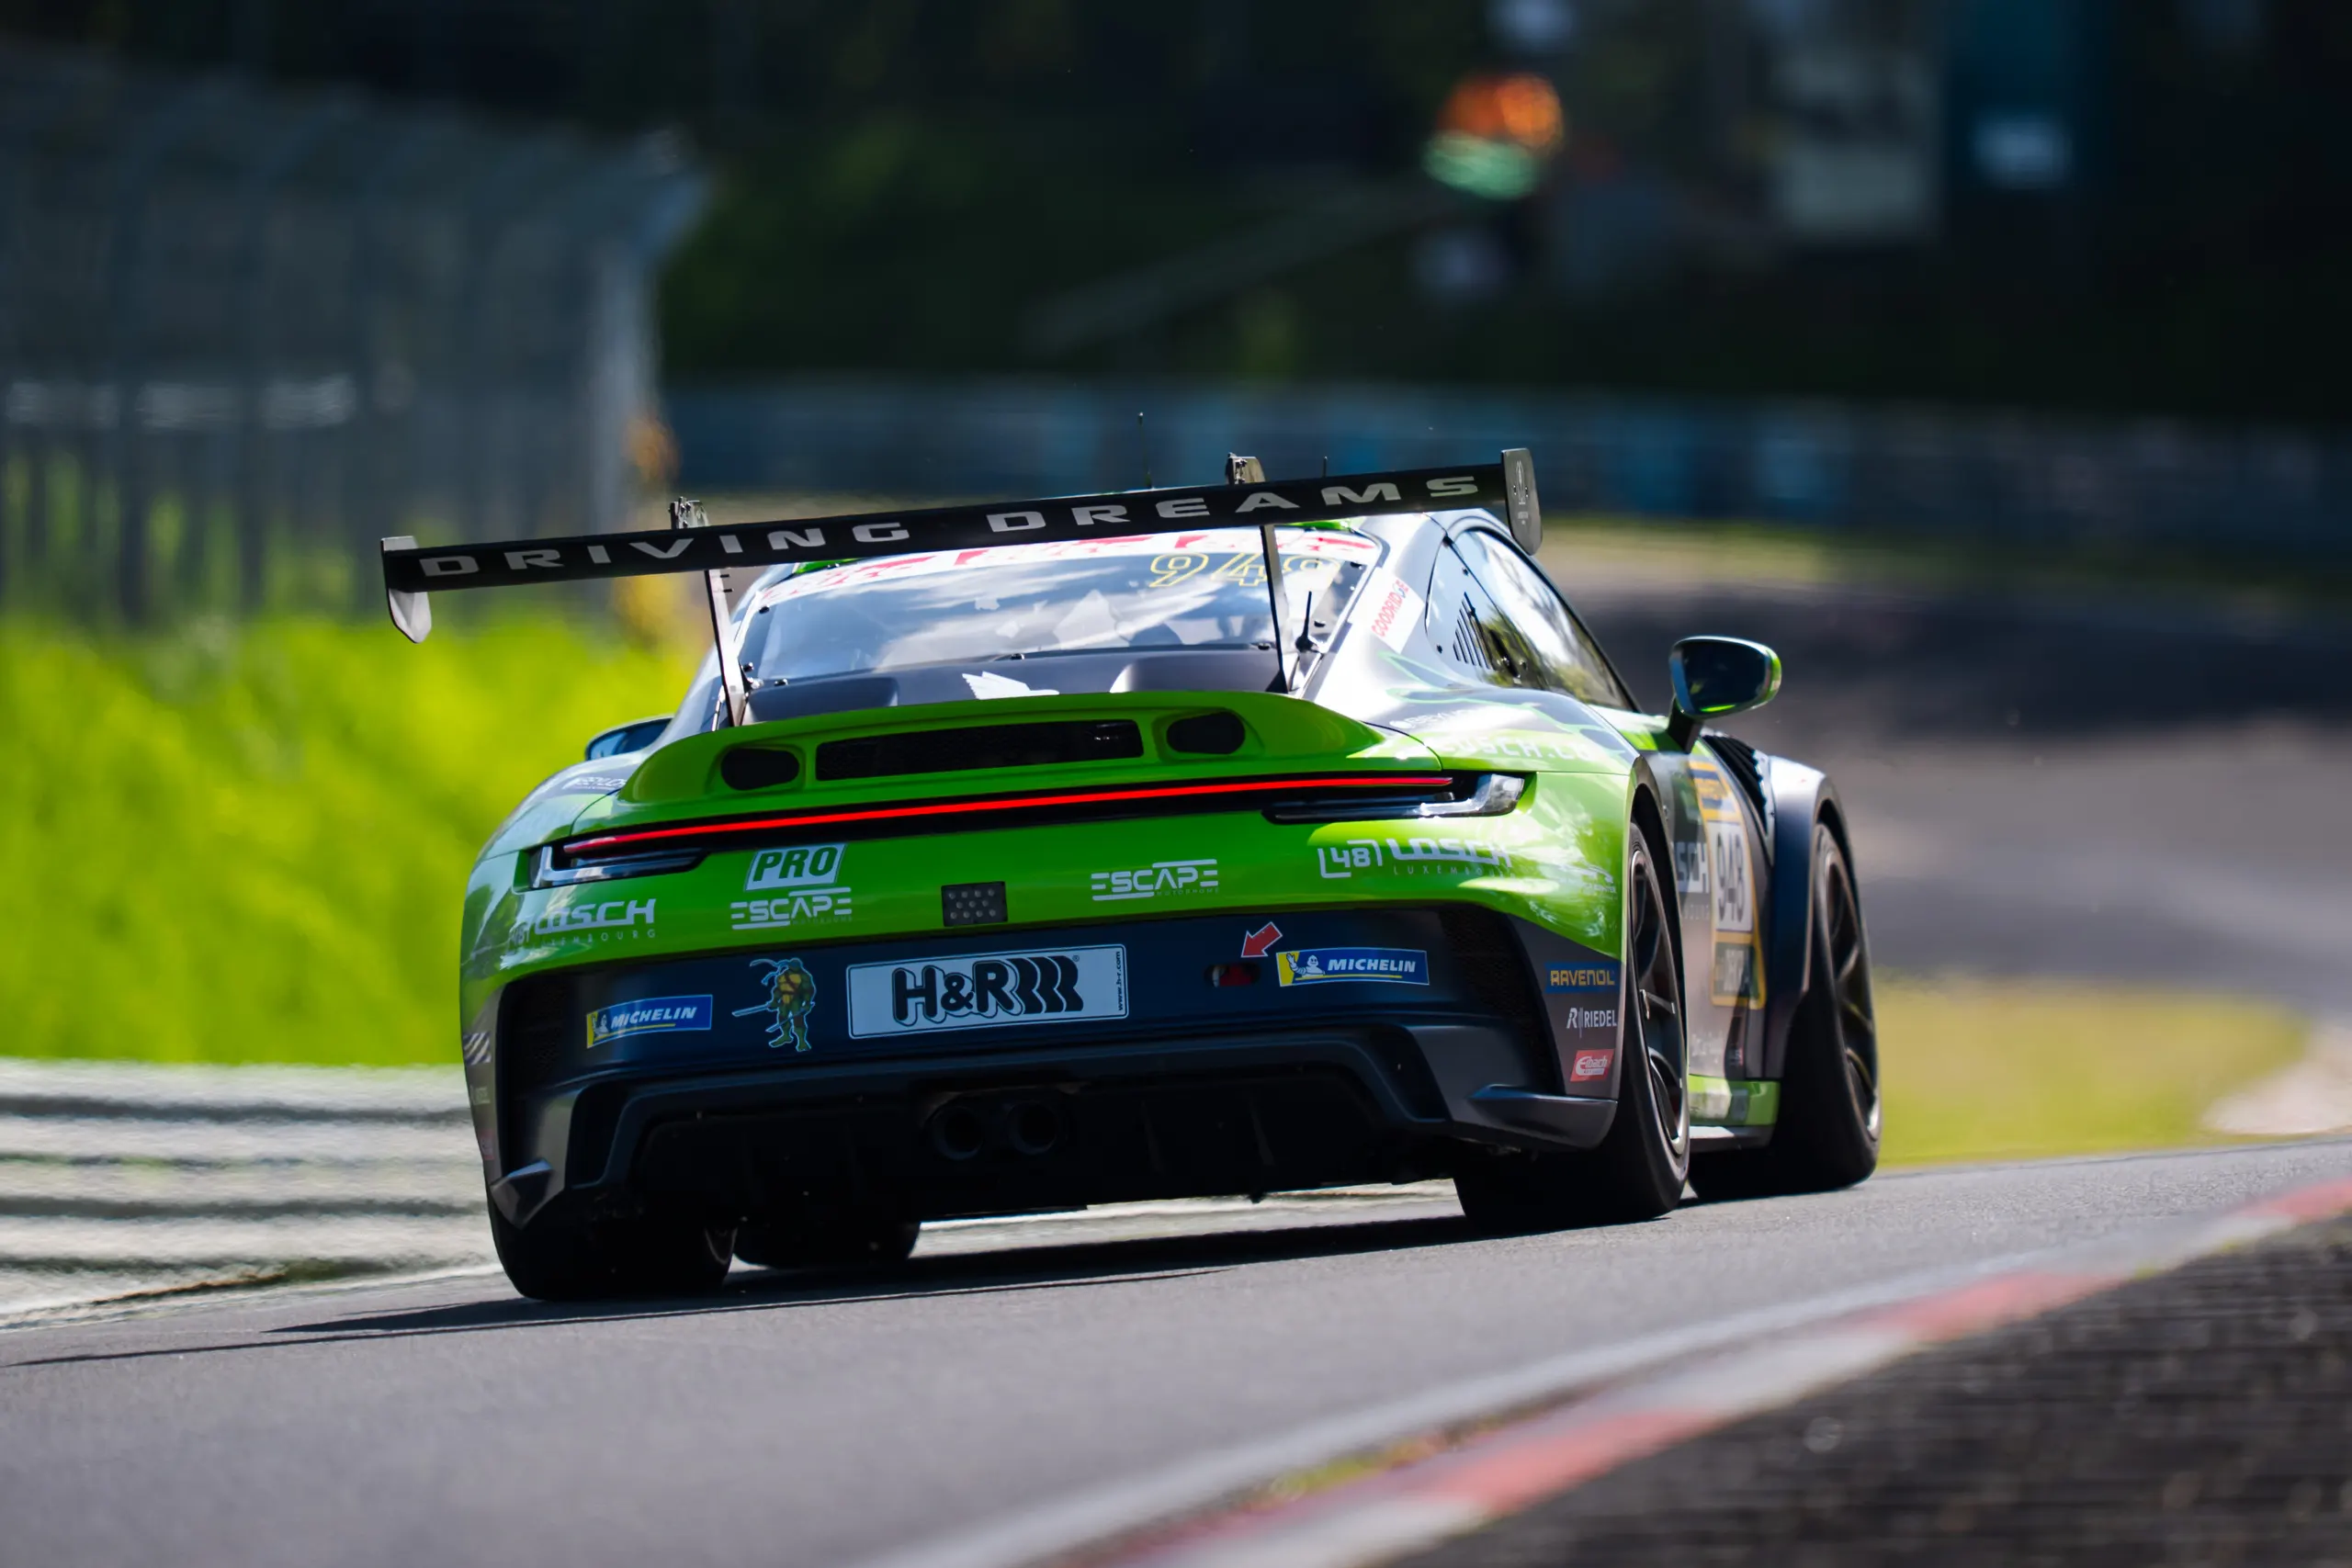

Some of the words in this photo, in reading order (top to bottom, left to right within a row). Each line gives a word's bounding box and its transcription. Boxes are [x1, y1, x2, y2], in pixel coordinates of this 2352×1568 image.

[420, 521, 910, 578] DRIVING
[986, 476, 1478, 534] DREAMS
[752, 846, 839, 882] PRO
[1386, 838, 1512, 868] LOSCH
[1091, 859, 1219, 901] ESCAPE
[1716, 831, 1745, 923] 948
[729, 886, 853, 930] ESCAPE
[1328, 958, 1416, 973] MICHELIN
[1550, 969, 1615, 987] RAVENOL
[611, 1007, 697, 1029] MICHELIN
[1584, 1010, 1617, 1028] RIEDEL
